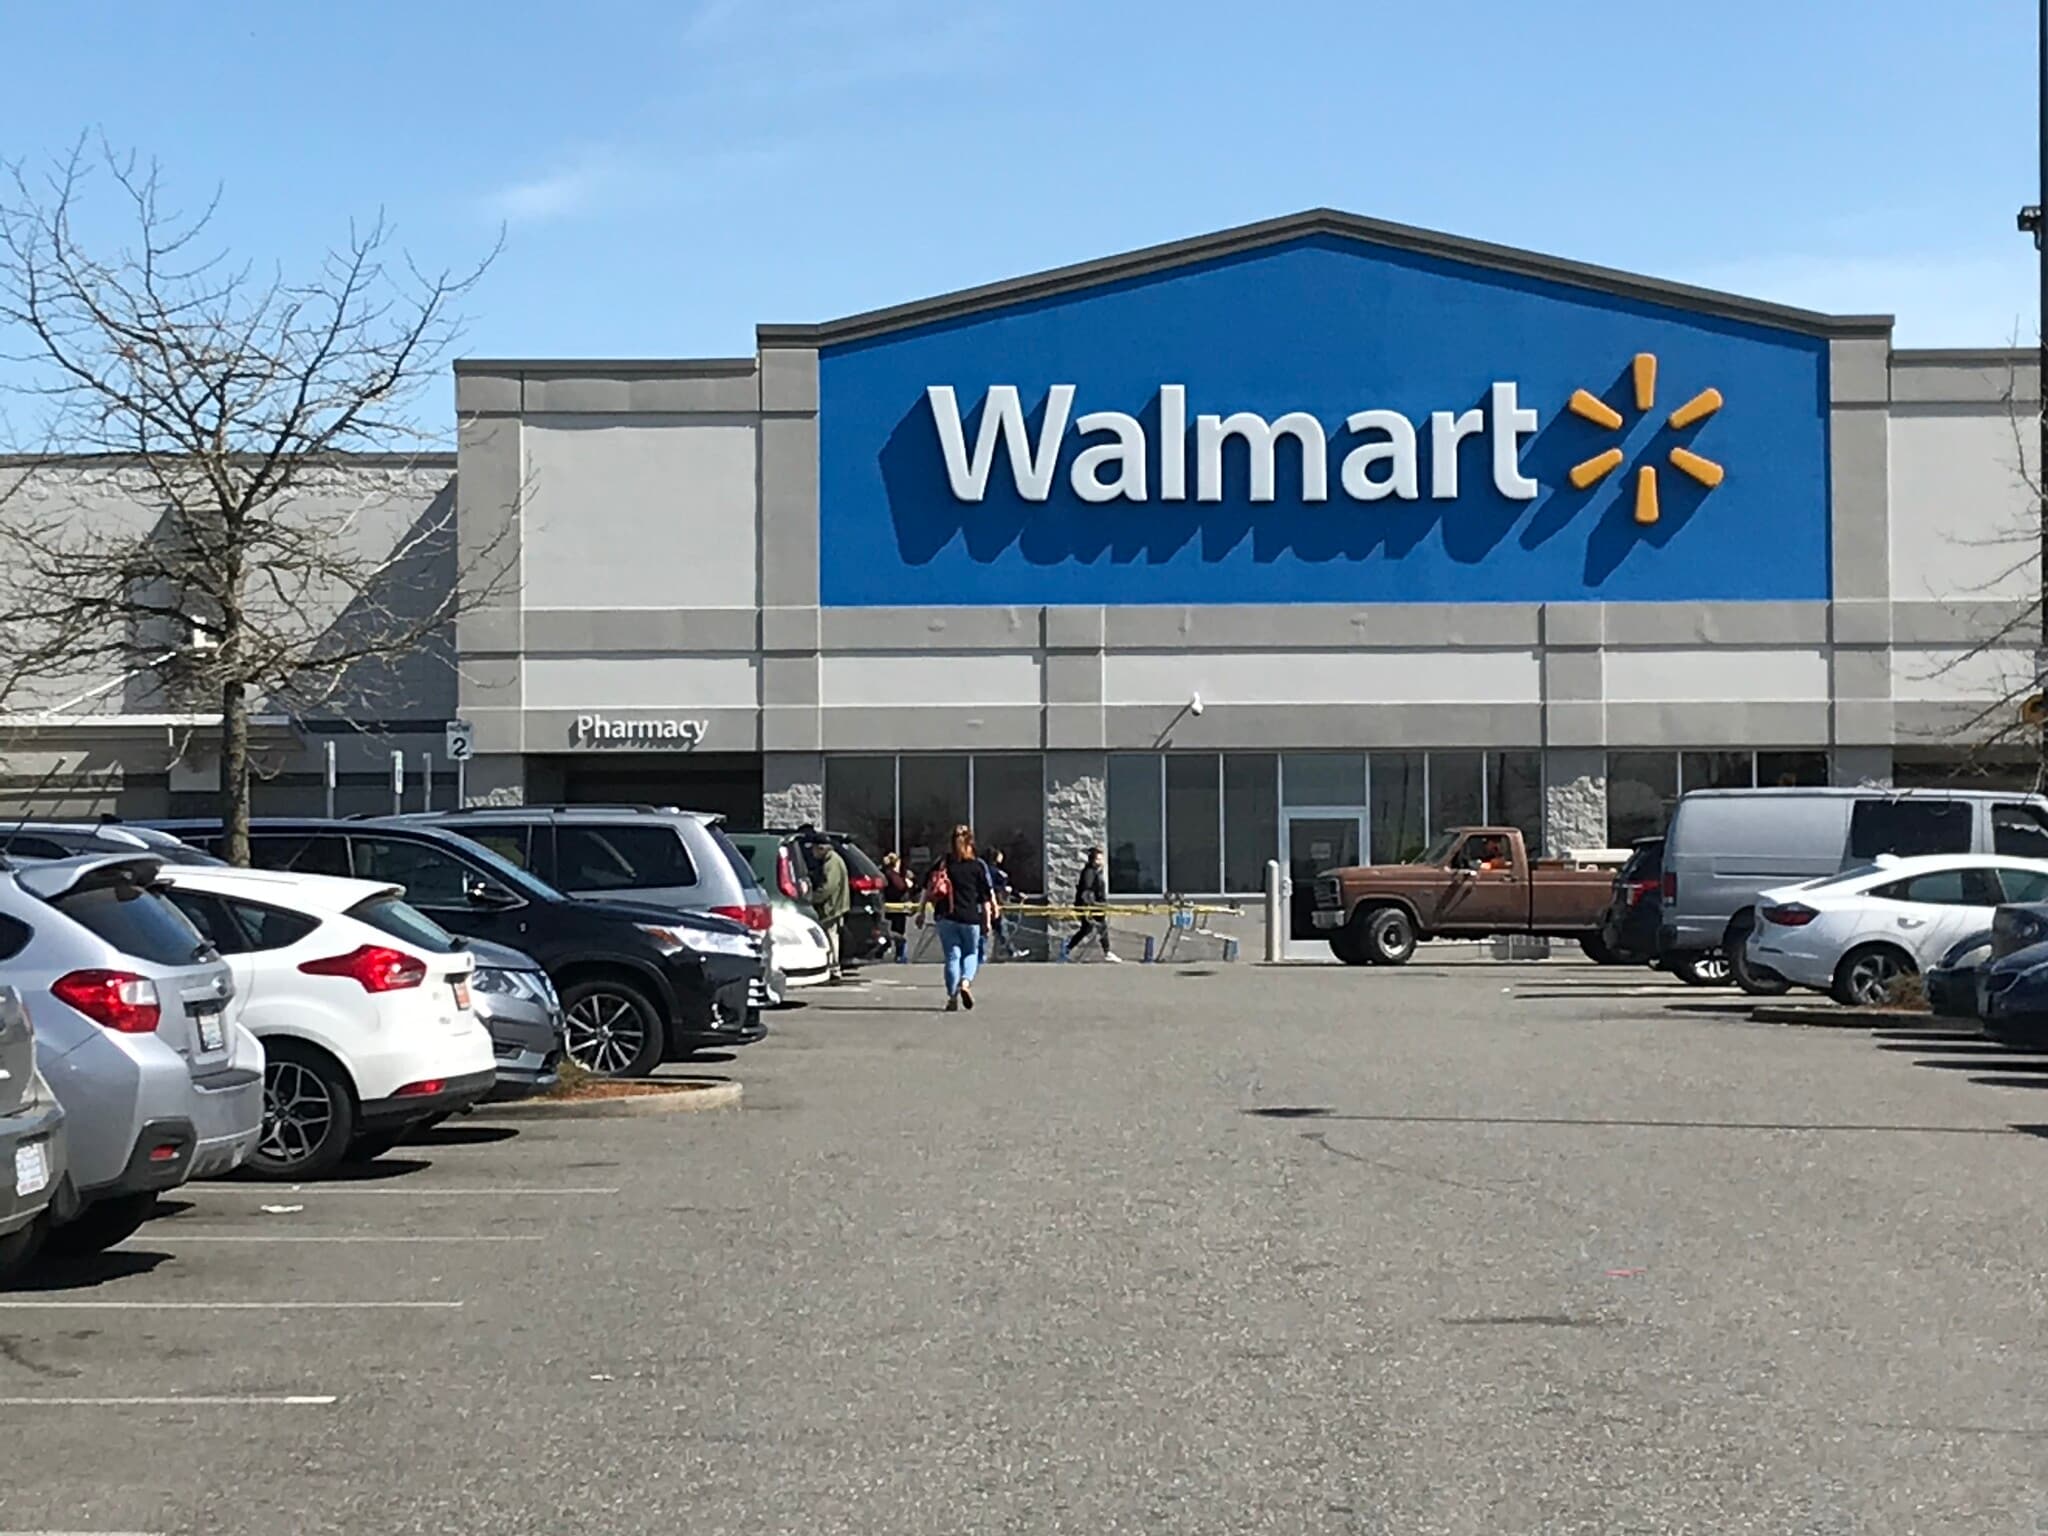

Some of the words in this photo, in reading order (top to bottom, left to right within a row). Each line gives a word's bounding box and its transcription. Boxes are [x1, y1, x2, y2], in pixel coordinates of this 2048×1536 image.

[926, 380, 1539, 502] Walmart
[577, 714, 709, 744] Pharmacy
[453, 736, 467, 757] 2
